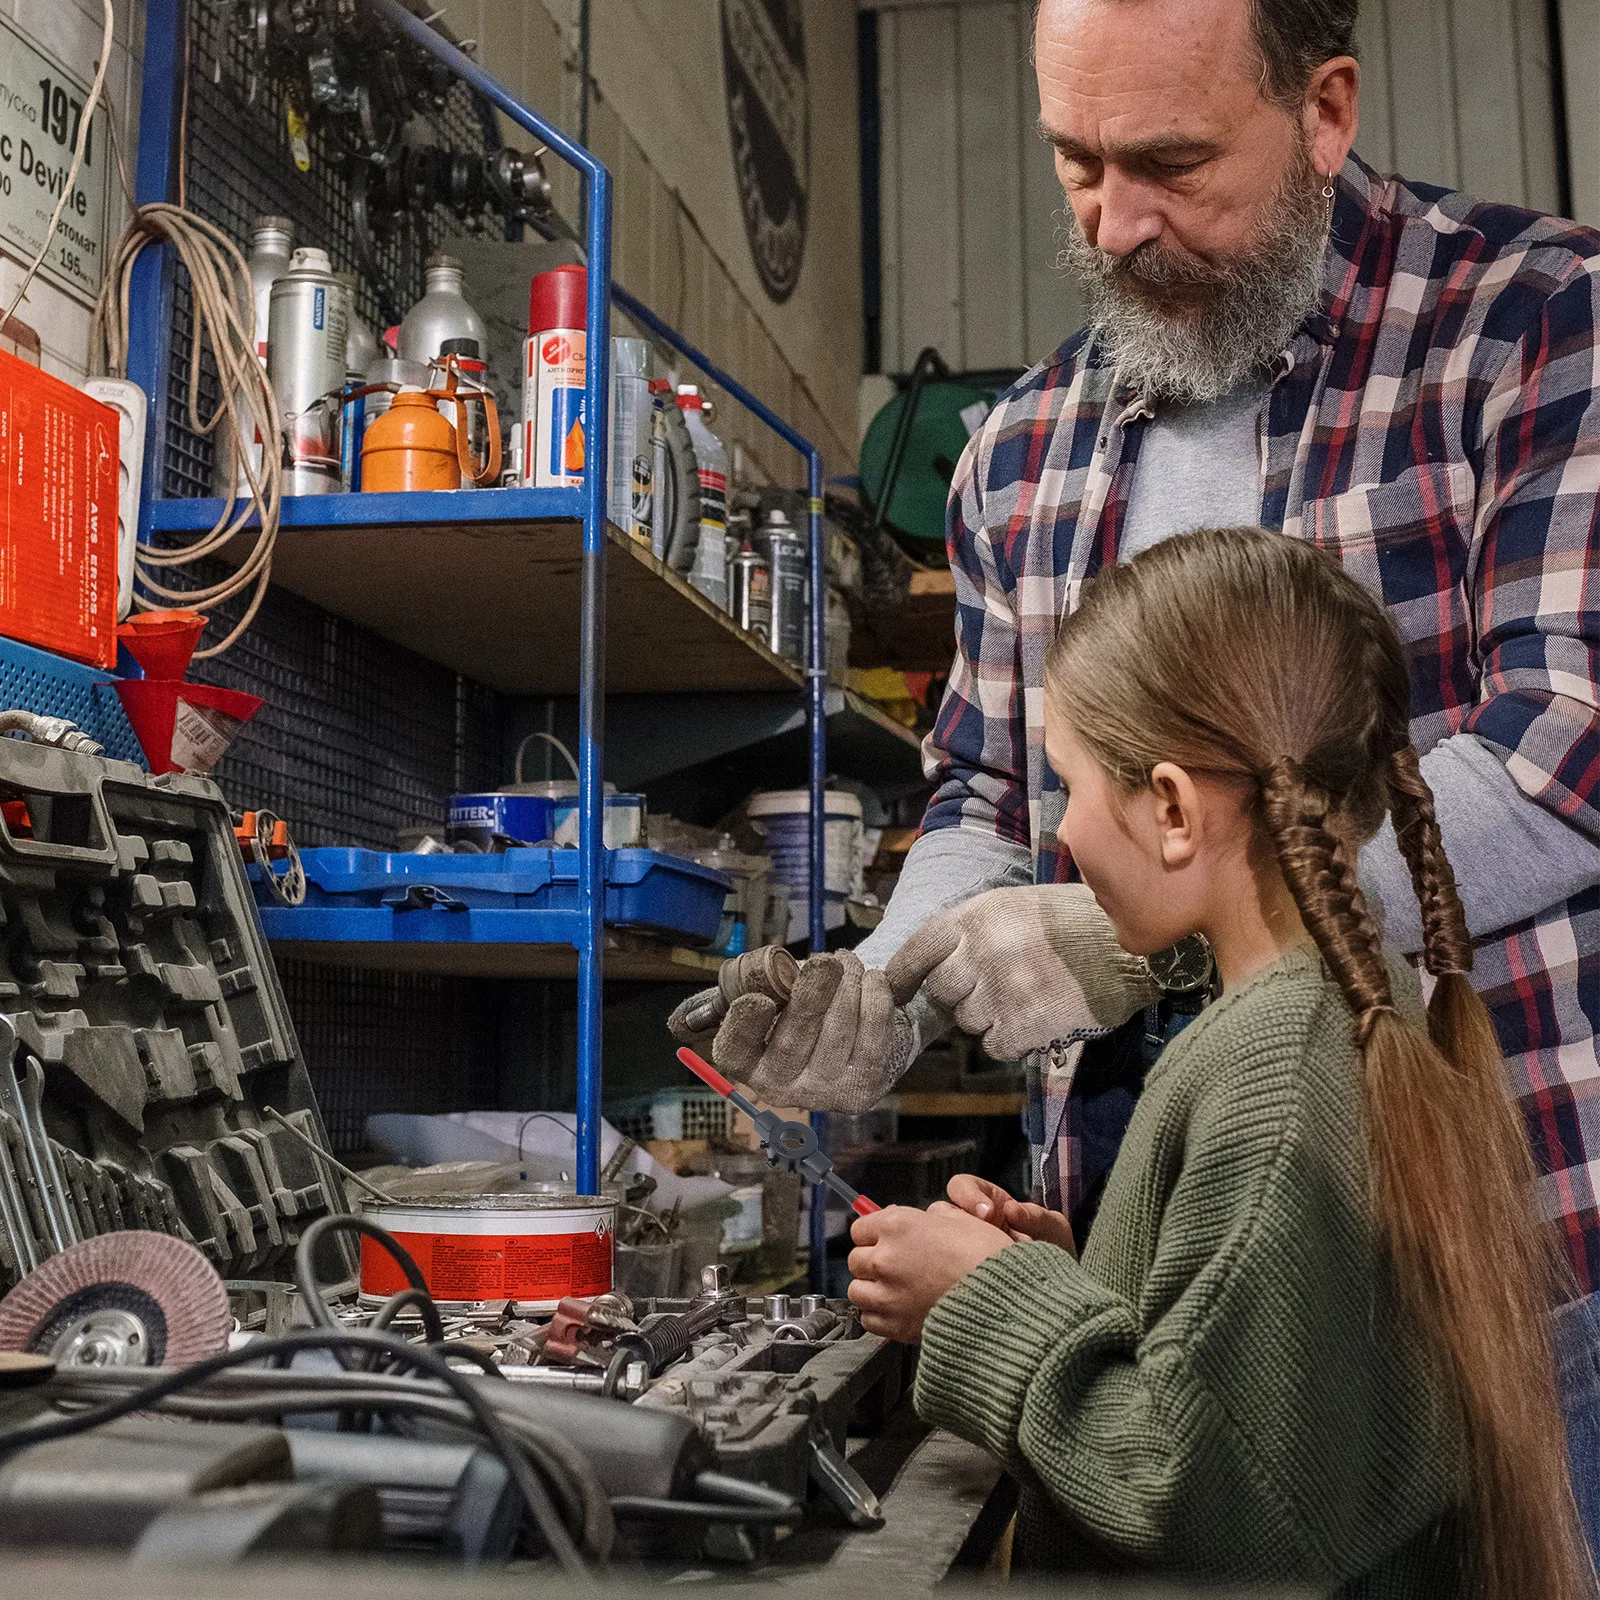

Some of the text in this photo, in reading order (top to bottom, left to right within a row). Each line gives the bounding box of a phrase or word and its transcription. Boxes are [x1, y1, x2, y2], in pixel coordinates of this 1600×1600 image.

[20, 138, 87, 216] Deville
[60, 247, 81, 277] 195
[315, 291, 323, 326] MASTON
[90, 501, 99, 638] AWS ER70S-6
